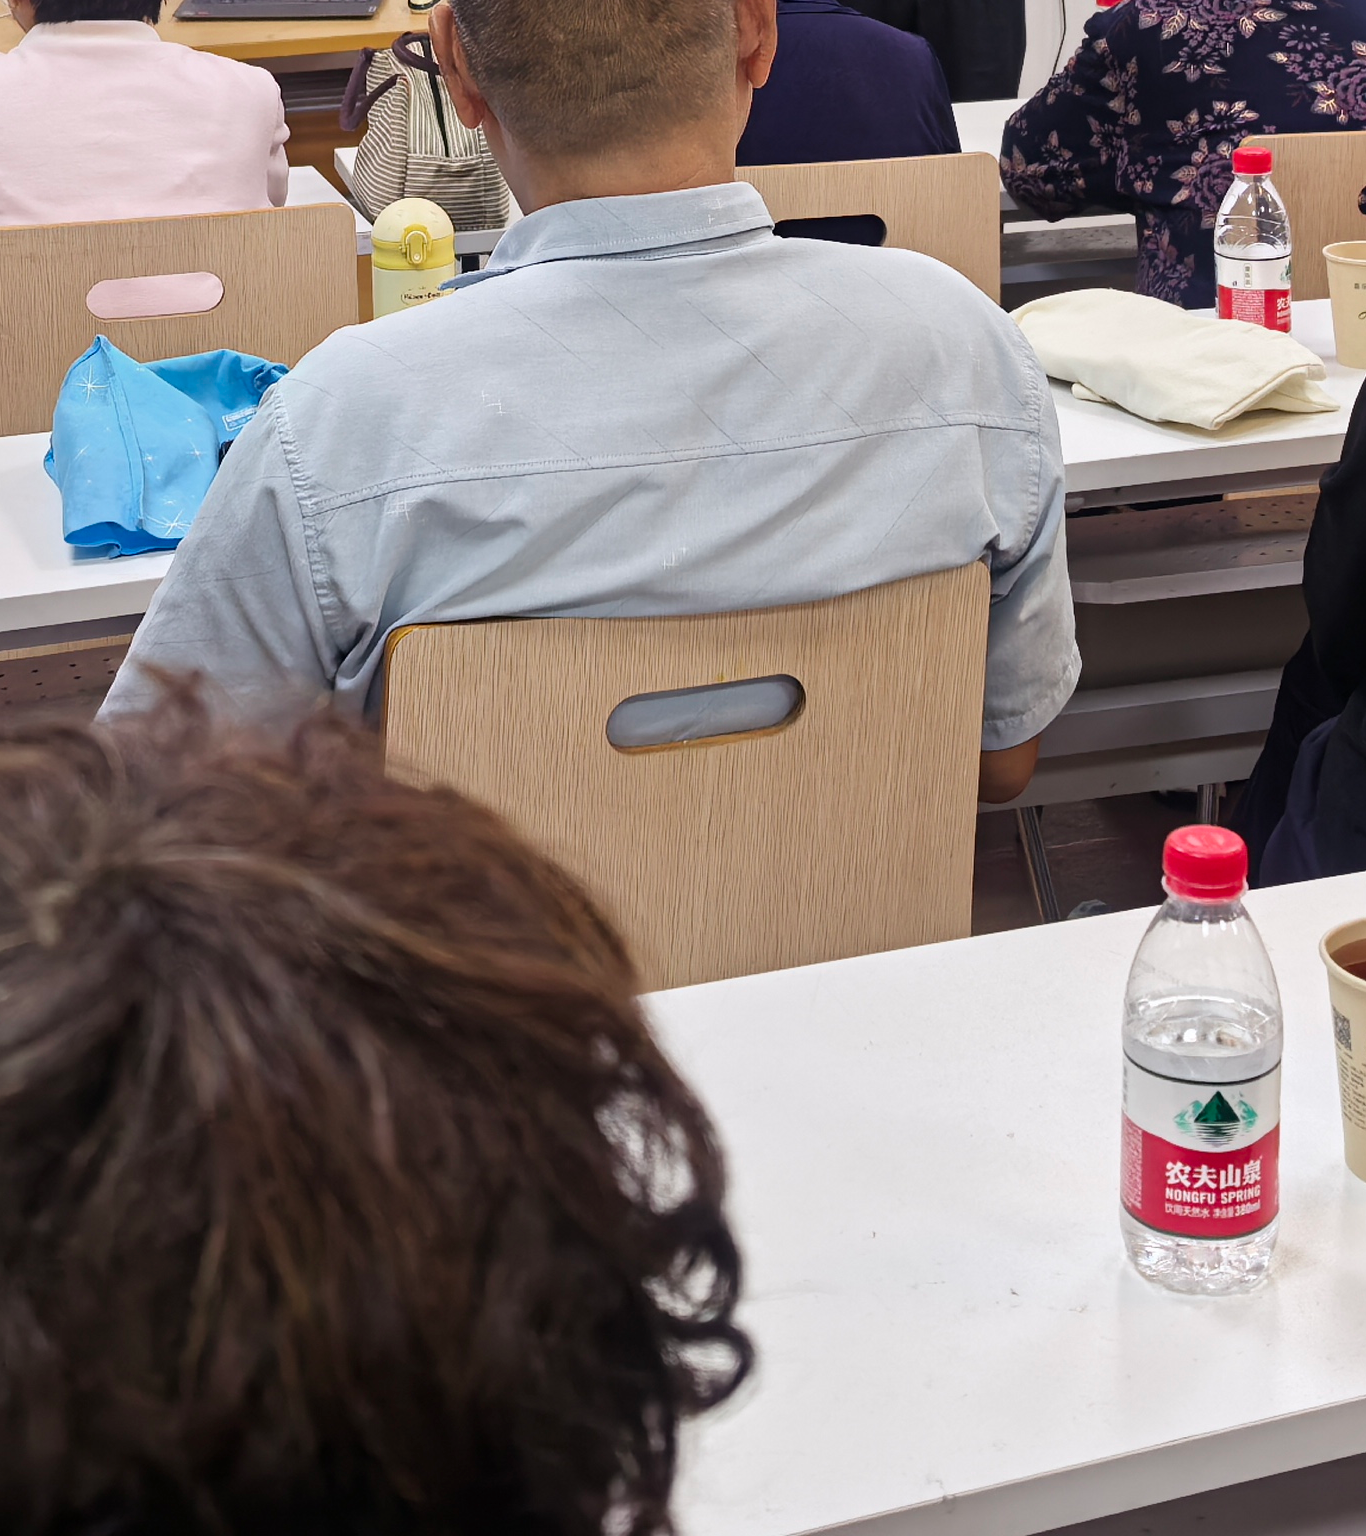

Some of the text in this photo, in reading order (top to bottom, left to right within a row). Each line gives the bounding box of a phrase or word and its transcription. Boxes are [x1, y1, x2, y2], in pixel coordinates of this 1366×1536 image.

[1165, 1159, 1261, 1189] 农夫山泉
[1165, 1185, 1261, 1204] NONGFU SPRING
